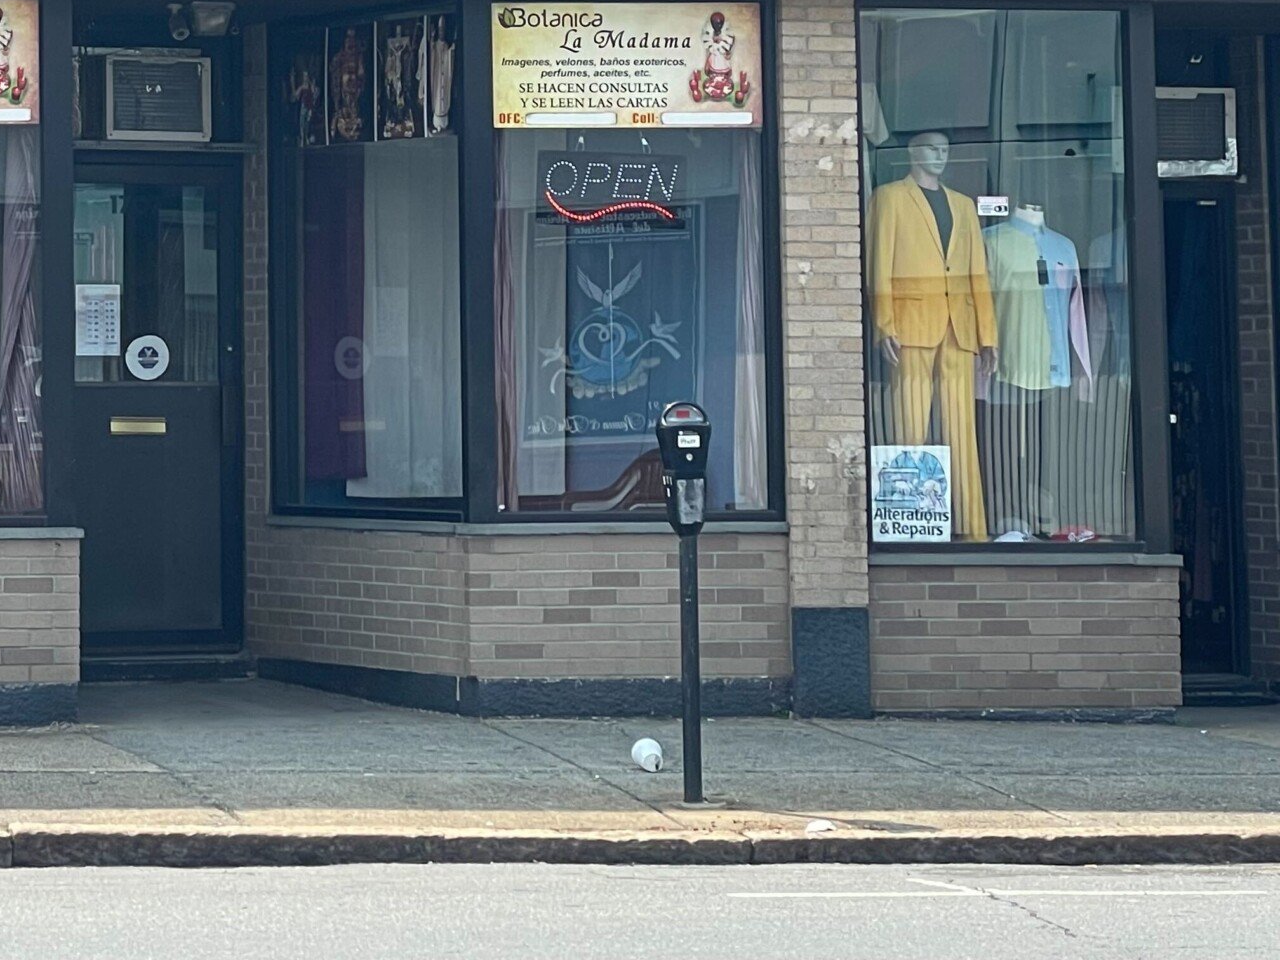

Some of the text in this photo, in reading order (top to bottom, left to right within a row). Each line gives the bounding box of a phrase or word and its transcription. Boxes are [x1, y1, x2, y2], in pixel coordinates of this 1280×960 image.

[511, 7, 603, 28] Botanica
[559, 29, 692, 53] La Madama
[501, 58, 687, 68] Imagenes, velones, baños exotericos,
[540, 69, 652, 79] perfumes, aceites, etc.
[519, 82, 668, 93] SE HACEN CONSULTAS
[520, 97, 668, 108] Y SE LEEN LAS CARTAS
[499, 113, 524, 124] OFC:
[546, 160, 678, 201] OPEN
[874, 506, 949, 522] Alterations
[880, 521, 943, 539] & Repairs
